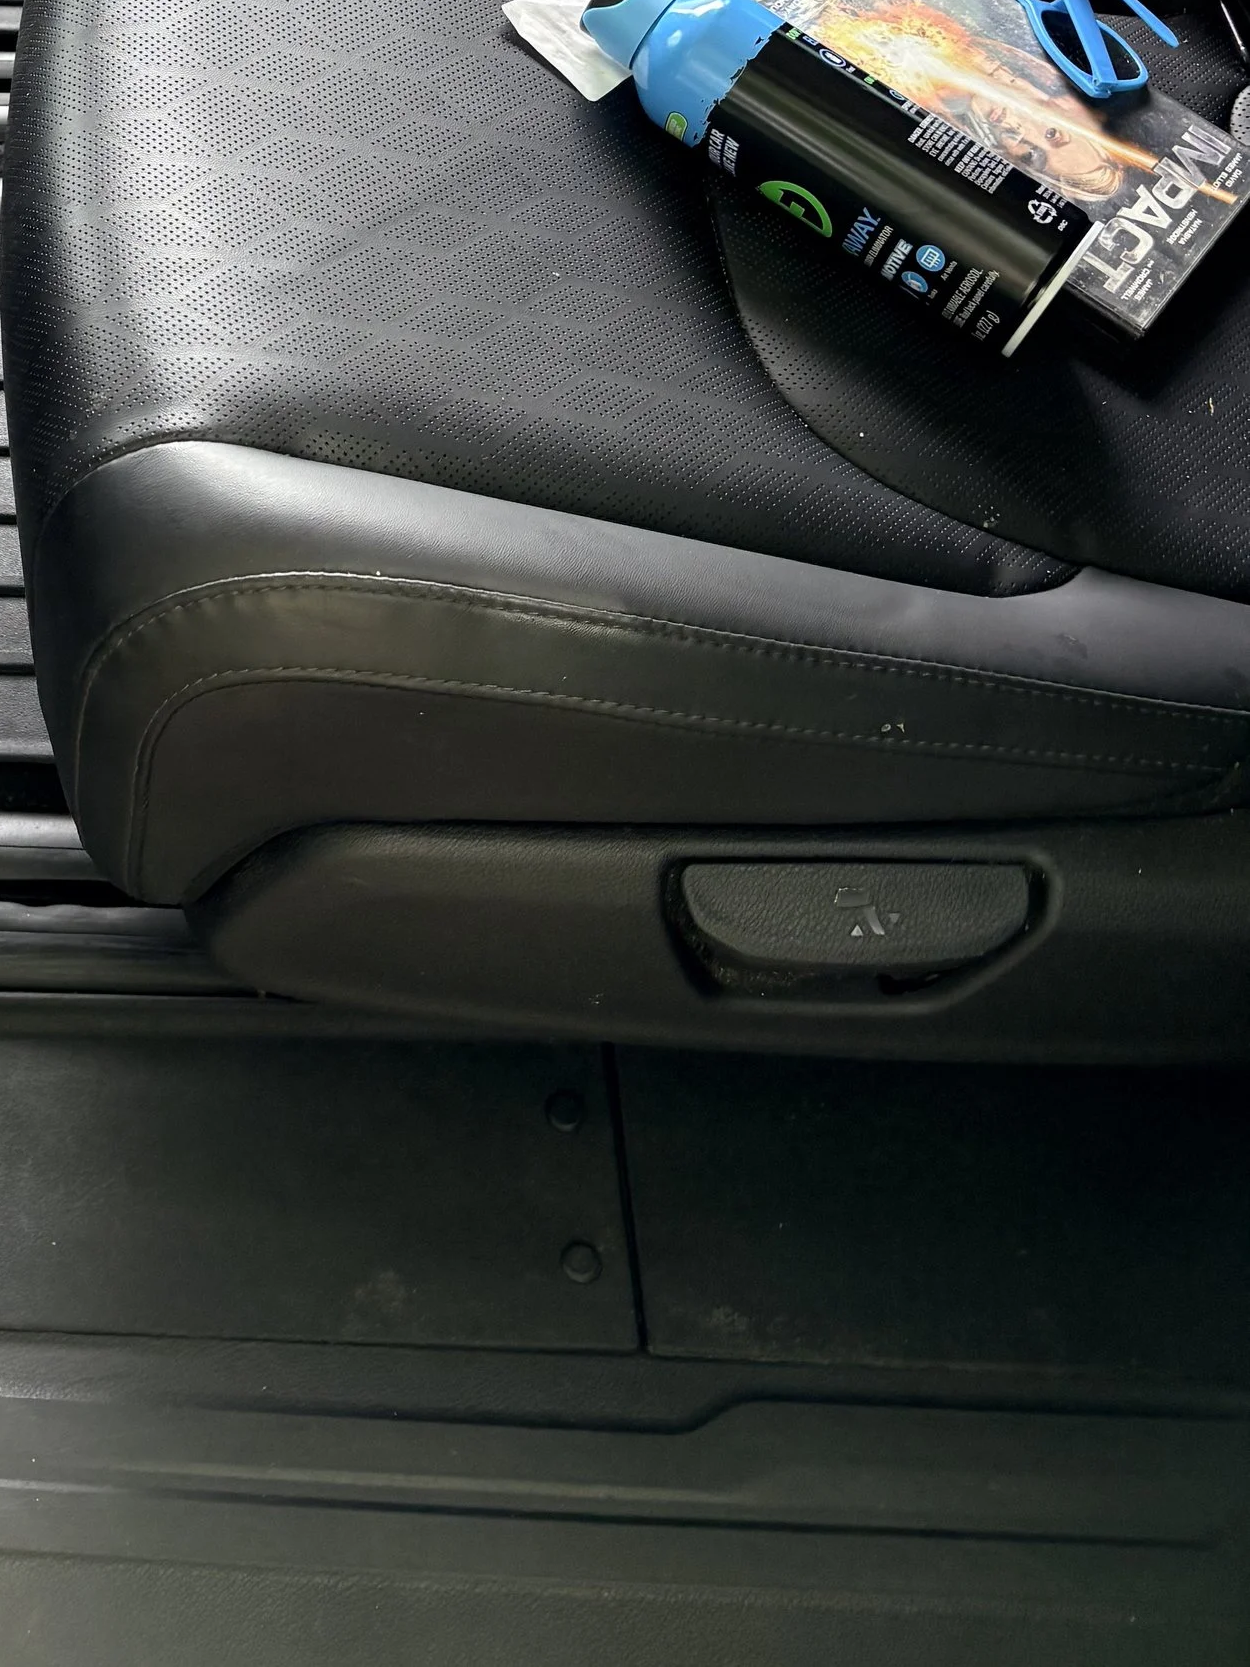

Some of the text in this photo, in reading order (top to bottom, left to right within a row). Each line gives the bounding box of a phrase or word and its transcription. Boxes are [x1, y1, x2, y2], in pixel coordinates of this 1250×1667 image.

[709, 128, 726, 150] CAR
[723, 135, 740, 163] NEW
[1224, 152, 1243, 173] JAMES
[1225, 169, 1243, 187] DAVID
[1083, 124, 1231, 294] IMPACT
[842, 207, 879, 256] AWAY
[1166, 208, 1198, 245] HENSTRIDGE
[1179, 219, 1203, 245] NATASHA
[959, 267, 984, 296] AEROSOL.
[1120, 268, 1150, 300] CROMWELL
[1134, 279, 1154, 301] JAMES
